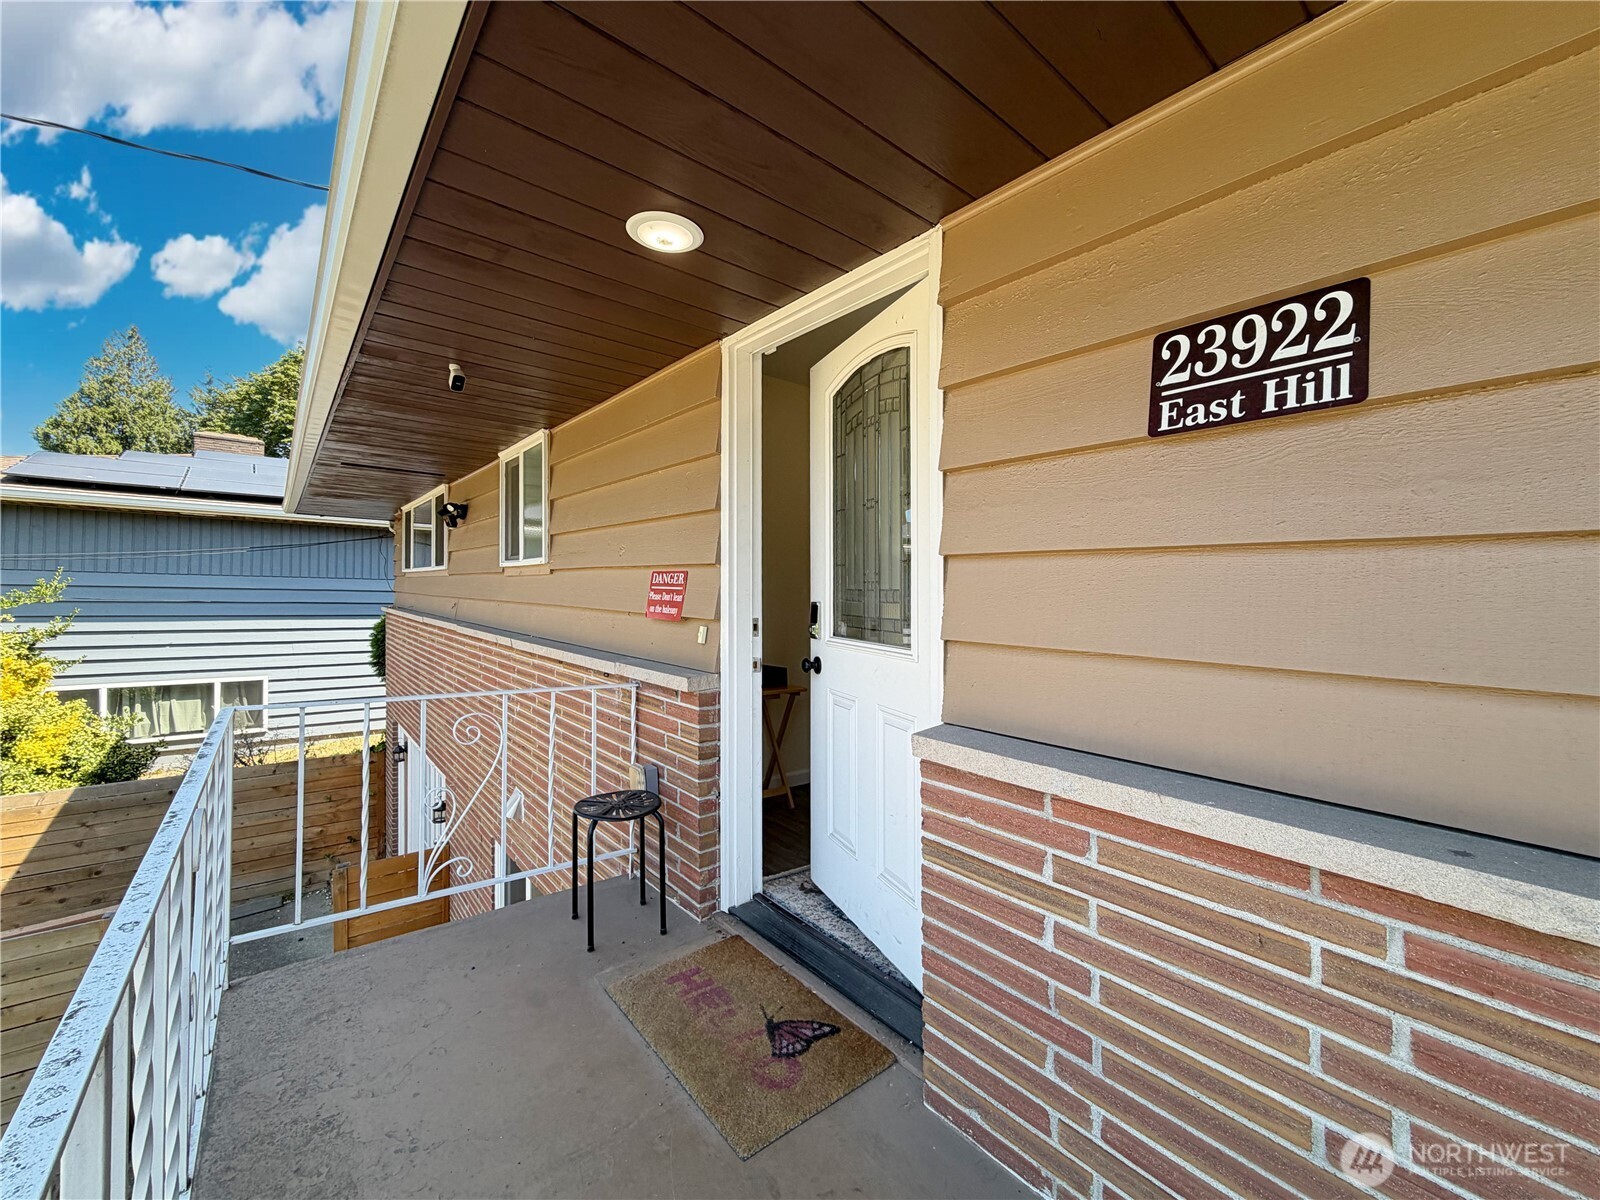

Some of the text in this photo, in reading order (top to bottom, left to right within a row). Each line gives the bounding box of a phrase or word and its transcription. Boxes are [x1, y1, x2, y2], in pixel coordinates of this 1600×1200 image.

[1160, 290, 1357, 387] 23922
[1157, 362, 1354, 432] East Hill
[649, 591, 661, 601] Please
[673, 592, 683, 602] lean
[652, 573, 684, 584] DANGER
